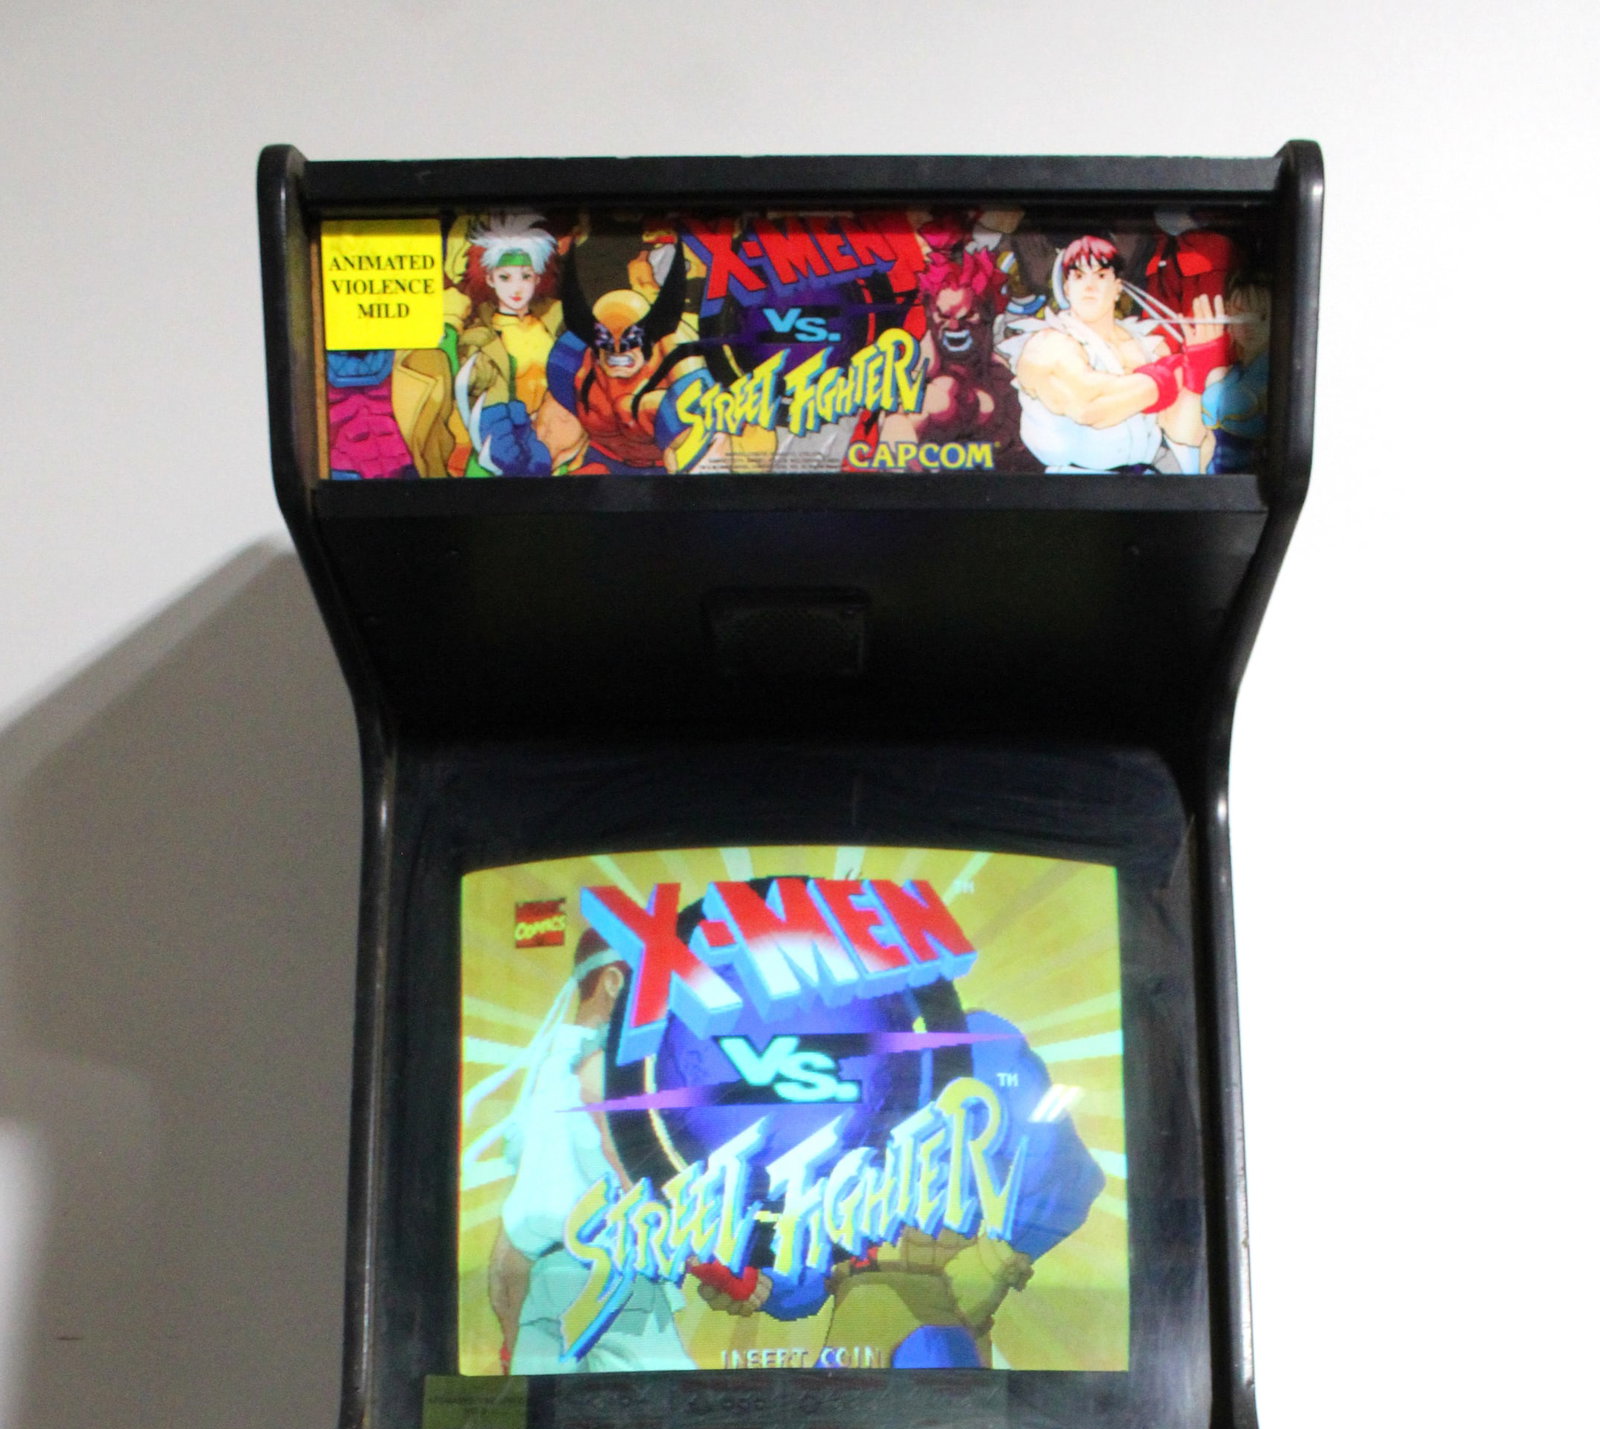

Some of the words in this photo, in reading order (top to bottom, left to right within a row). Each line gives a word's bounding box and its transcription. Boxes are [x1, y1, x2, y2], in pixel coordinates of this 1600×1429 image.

[329, 254, 436, 272] ANIMATED
[682, 214, 900, 318] X-MEN
[332, 279, 435, 296] VIOLENCE
[358, 303, 410, 319] MILD
[676, 348, 791, 474] STREET
[784, 328, 930, 437] FIGHTER
[848, 441, 993, 470] CAPCOM
[580, 878, 978, 1067] X-MEN
[560, 1112, 774, 1364] STREET
[765, 1077, 1028, 1286] FIGHTER
[721, 1348, 809, 1368] INSERT
[820, 1345, 885, 1368] COIN
